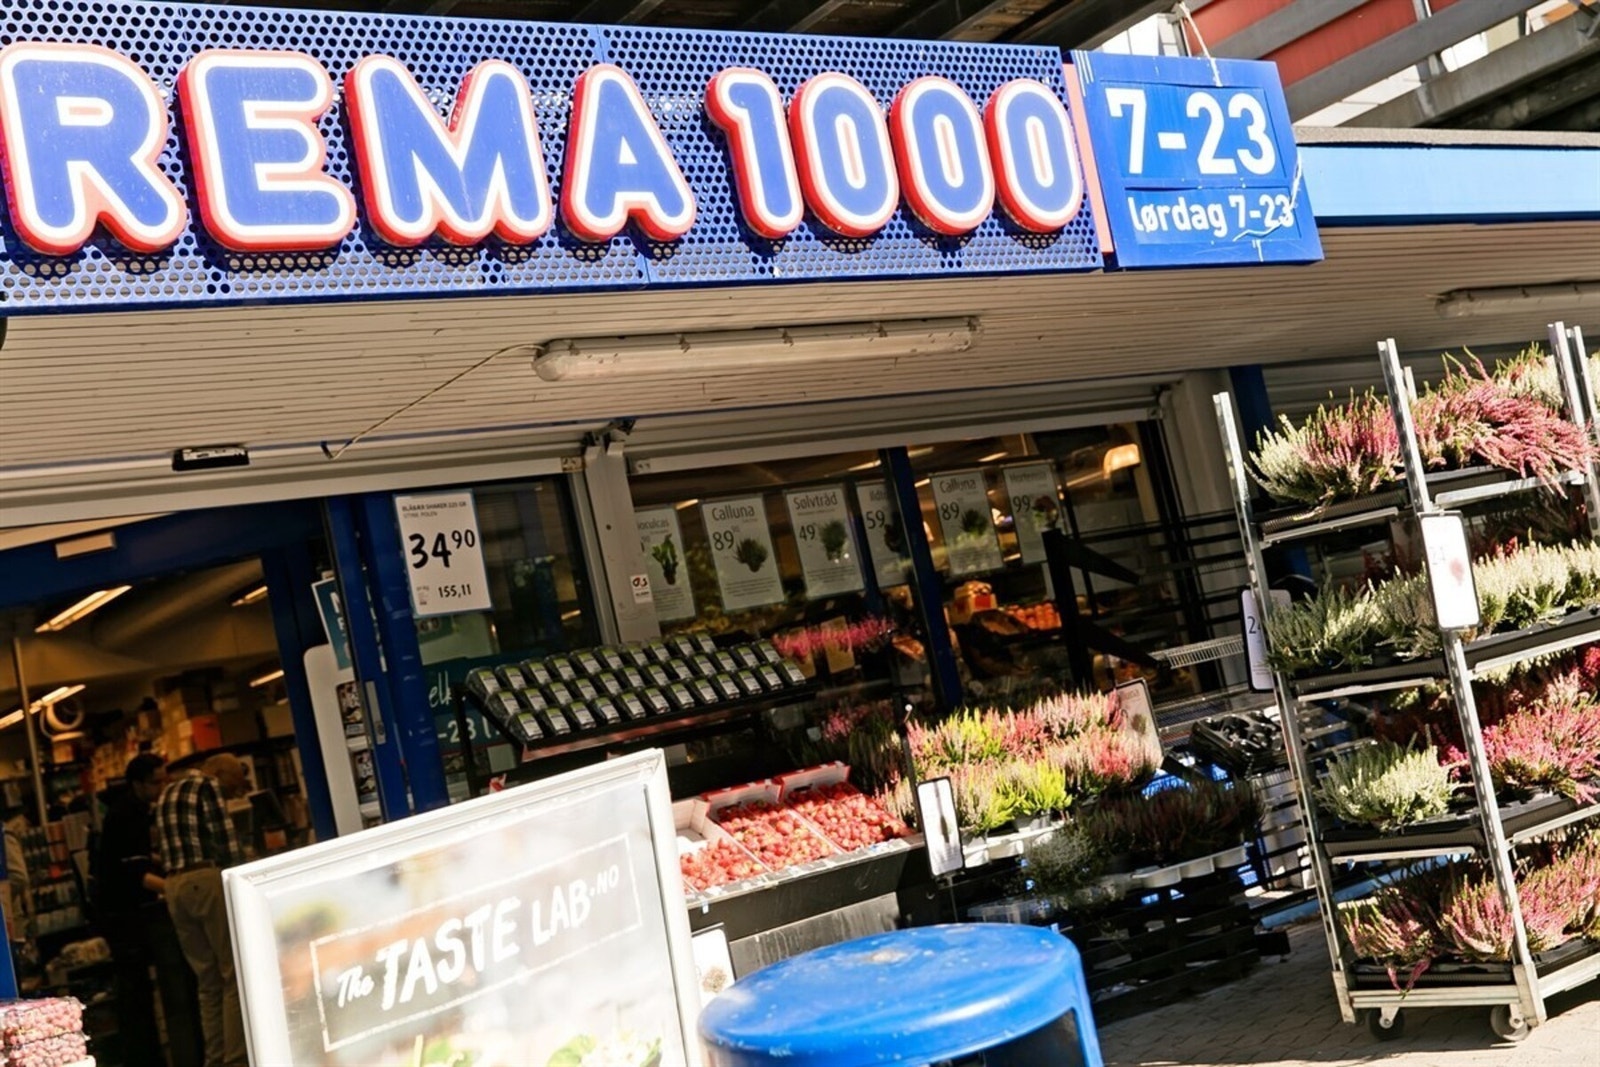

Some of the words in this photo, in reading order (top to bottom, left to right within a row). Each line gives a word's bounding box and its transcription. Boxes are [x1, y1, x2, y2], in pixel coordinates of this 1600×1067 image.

[0, 41, 697, 253] REMA
[705, 66, 1085, 239] 1000
[1105, 87, 1276, 175] 7-23
[1127, 197, 1228, 238] lørdag
[1229, 194, 1295, 229] 7-23
[711, 503, 755, 521] Calluna
[865, 509, 885, 530] 59
[799, 524, 816, 541] 49
[437, 583, 472, 599] 155,11
[336, 965, 375, 1008] The
[375, 896, 522, 1011] TASTE
